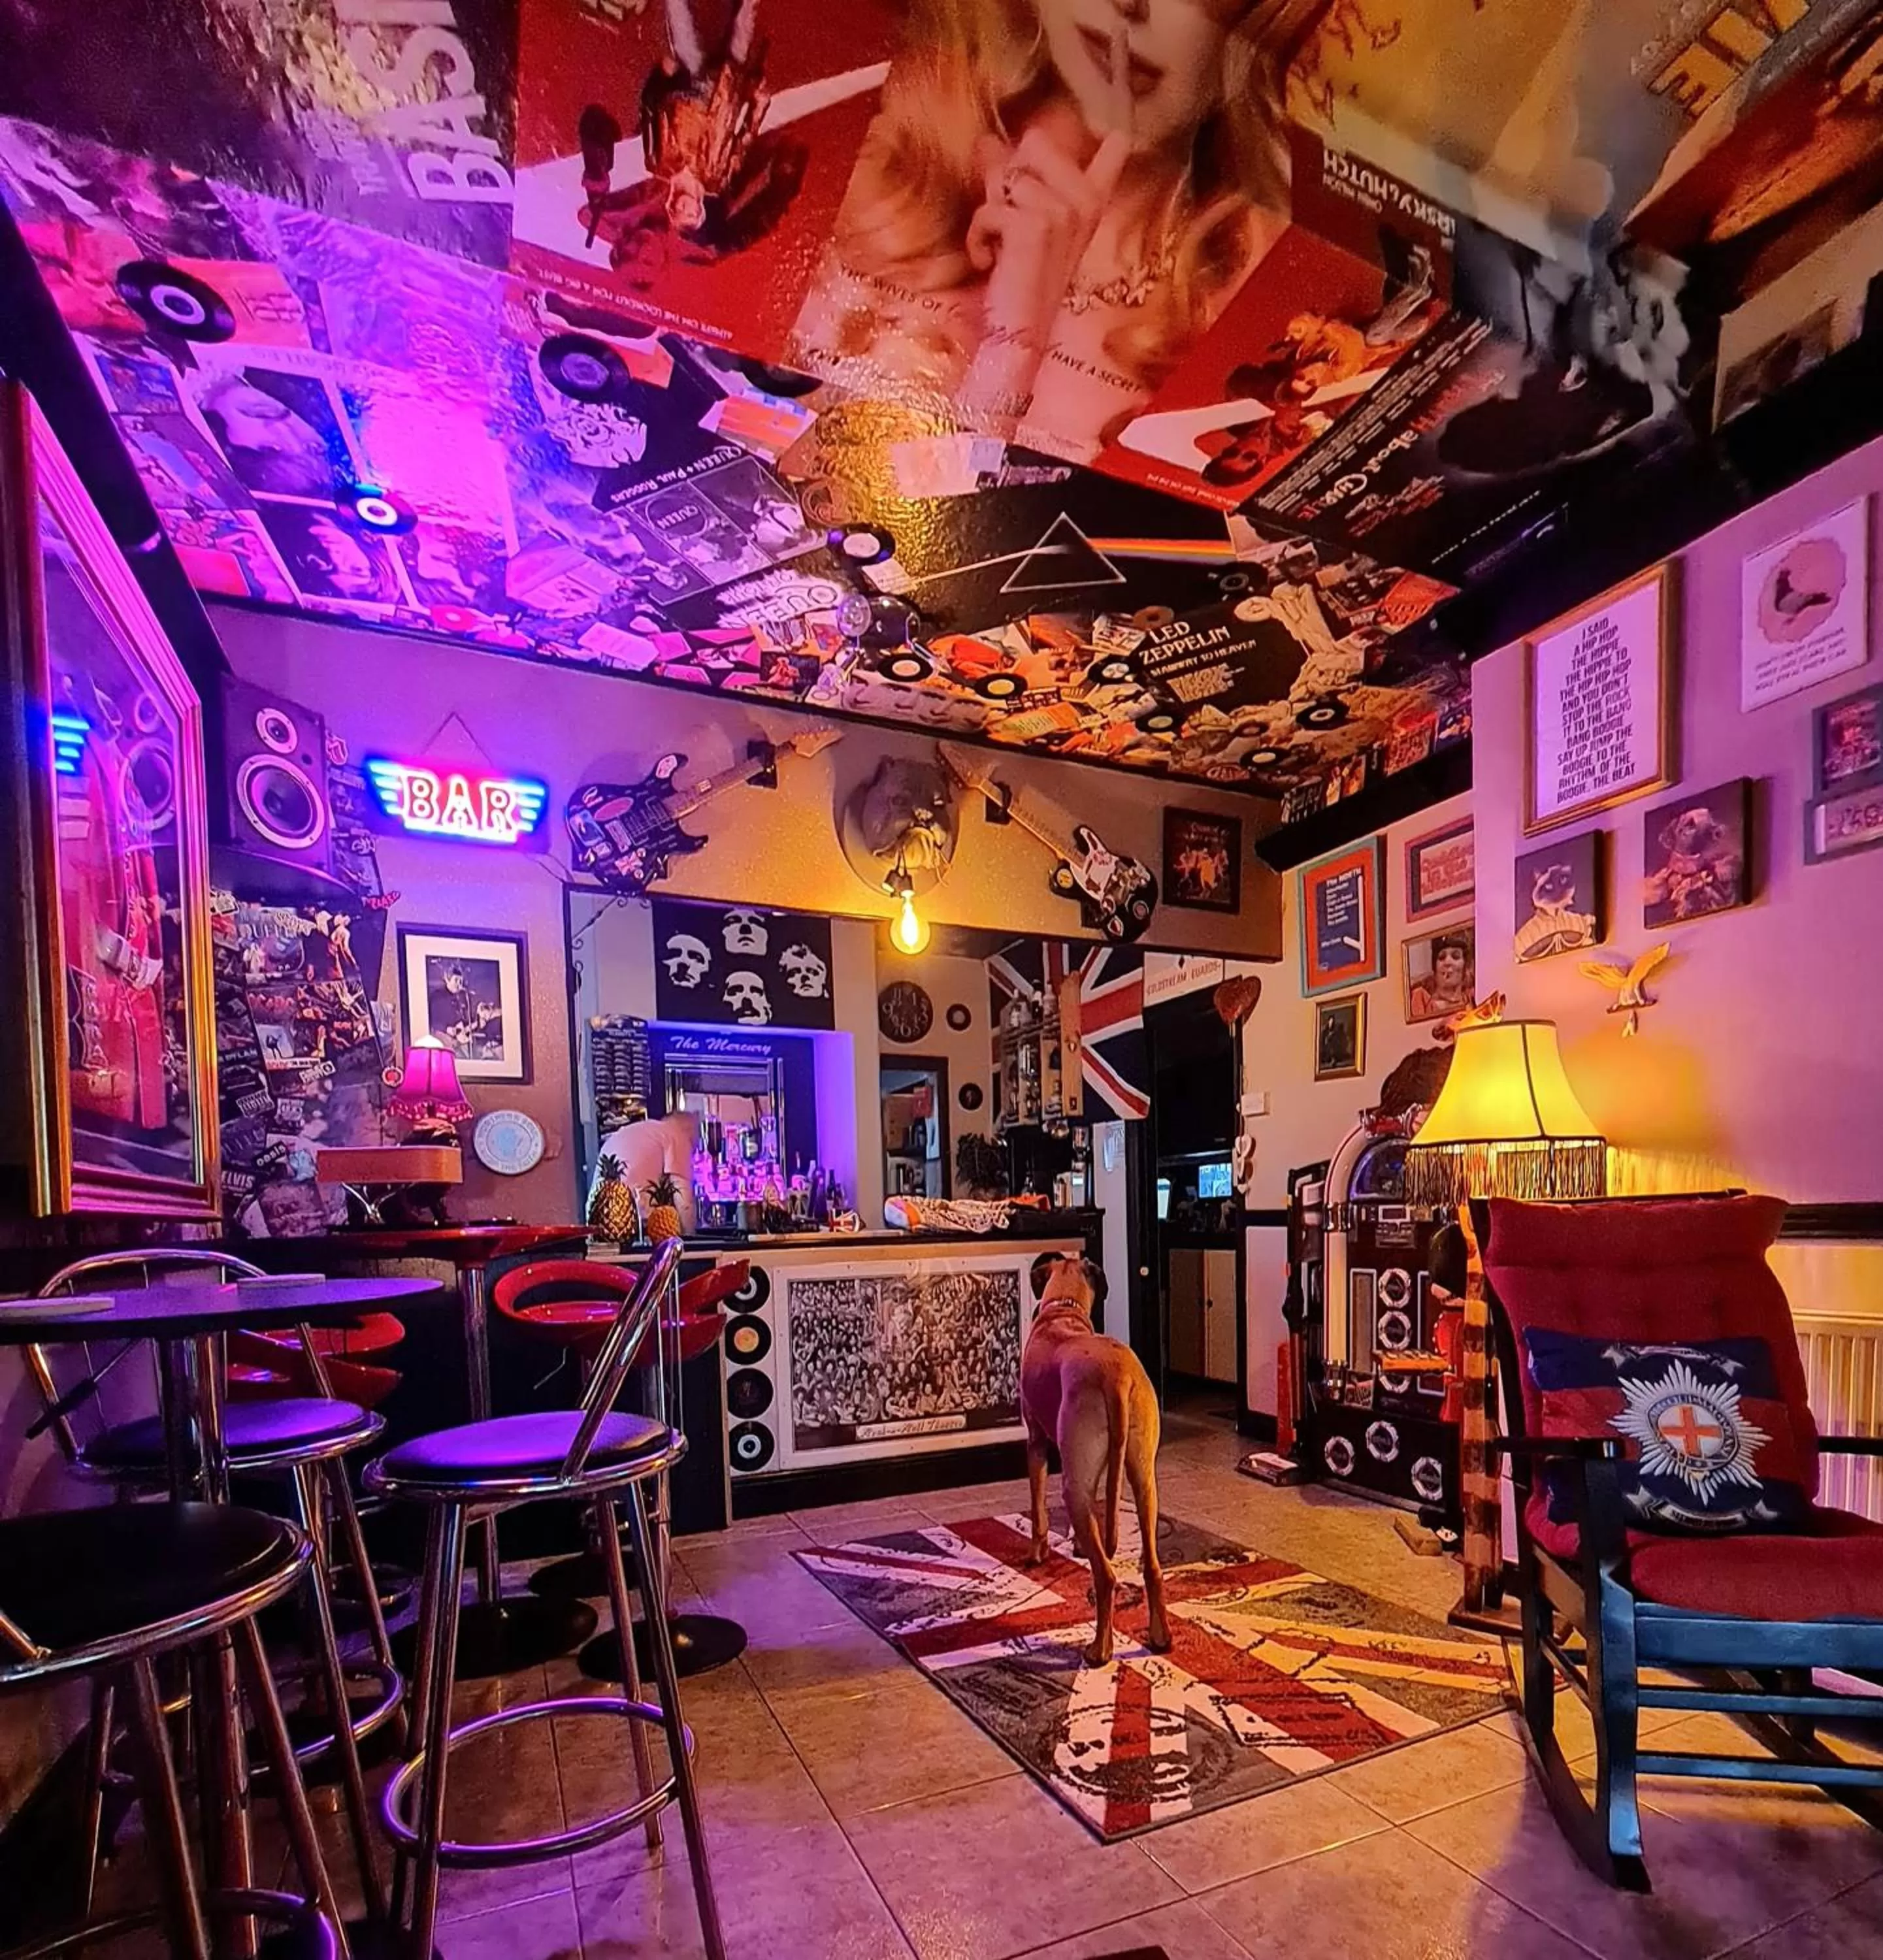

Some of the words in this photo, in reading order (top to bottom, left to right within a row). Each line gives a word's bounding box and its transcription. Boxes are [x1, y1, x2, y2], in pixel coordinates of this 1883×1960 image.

[1320, 148, 1390, 201] HUTCH
[615, 291, 663, 317] LOOKOUT
[1051, 350, 1085, 372] HAVE
[1086, 365, 1096, 376] A
[693, 444, 743, 473] QUEEN
[1359, 425, 1416, 478] about
[656, 503, 699, 531] QUEEN
[721, 580, 840, 632] QUEEN
[1149, 621, 1190, 644] LED
[1582, 636, 1597, 653] HIP
[1599, 625, 1618, 644] HOP
[1588, 617, 1609, 636] SAID
[1139, 625, 1231, 665] ZEPPELIN
[1572, 655, 1586, 670] THE
[1591, 638, 1618, 661] HIPPIE
[1560, 685, 1574, 702] THE
[1579, 678, 1593, 693] HIP
[1595, 669, 1610, 685] HIP
[1613, 659, 1631, 676] HOP
[1566, 670, 1580, 686] THE
[1584, 654, 1611, 678] HIPPIE
[1616, 647, 1628, 662] TO
[1562, 696, 1579, 713] AND
[1582, 687, 1599, 704] YOU
[1562, 706, 1584, 727] STOP
[1587, 698, 1601, 715] THE
[1574, 719, 1584, 732] TO
[1587, 711, 1601, 727] THE
[1607, 698, 1631, 719] BANG
[1558, 749, 1573, 766] SAY
[1575, 743, 1588, 757] UP
[1590, 732, 1613, 752] JUMP
[1616, 723, 1633, 742] THE
[1567, 729, 1590, 749] BANG
[1593, 714, 1624, 738] BOOGIE
[1559, 765, 1596, 789] RHYTHM
[1600, 759, 1611, 773] OF
[1614, 751, 1631, 769] THE
[1563, 753, 1592, 776] BOOGIE
[1597, 748, 1608, 762] TO
[1610, 740, 1626, 757] THE
[1594, 774, 1609, 789] THE
[1613, 762, 1635, 781] BEAT
[401, 770, 517, 840] BAR
[670, 1036, 699, 1049] The
[705, 1037, 772, 1056] Mercury
[256, 1141, 287, 1167] oasis
[221, 1170, 255, 1188] ELVIS
